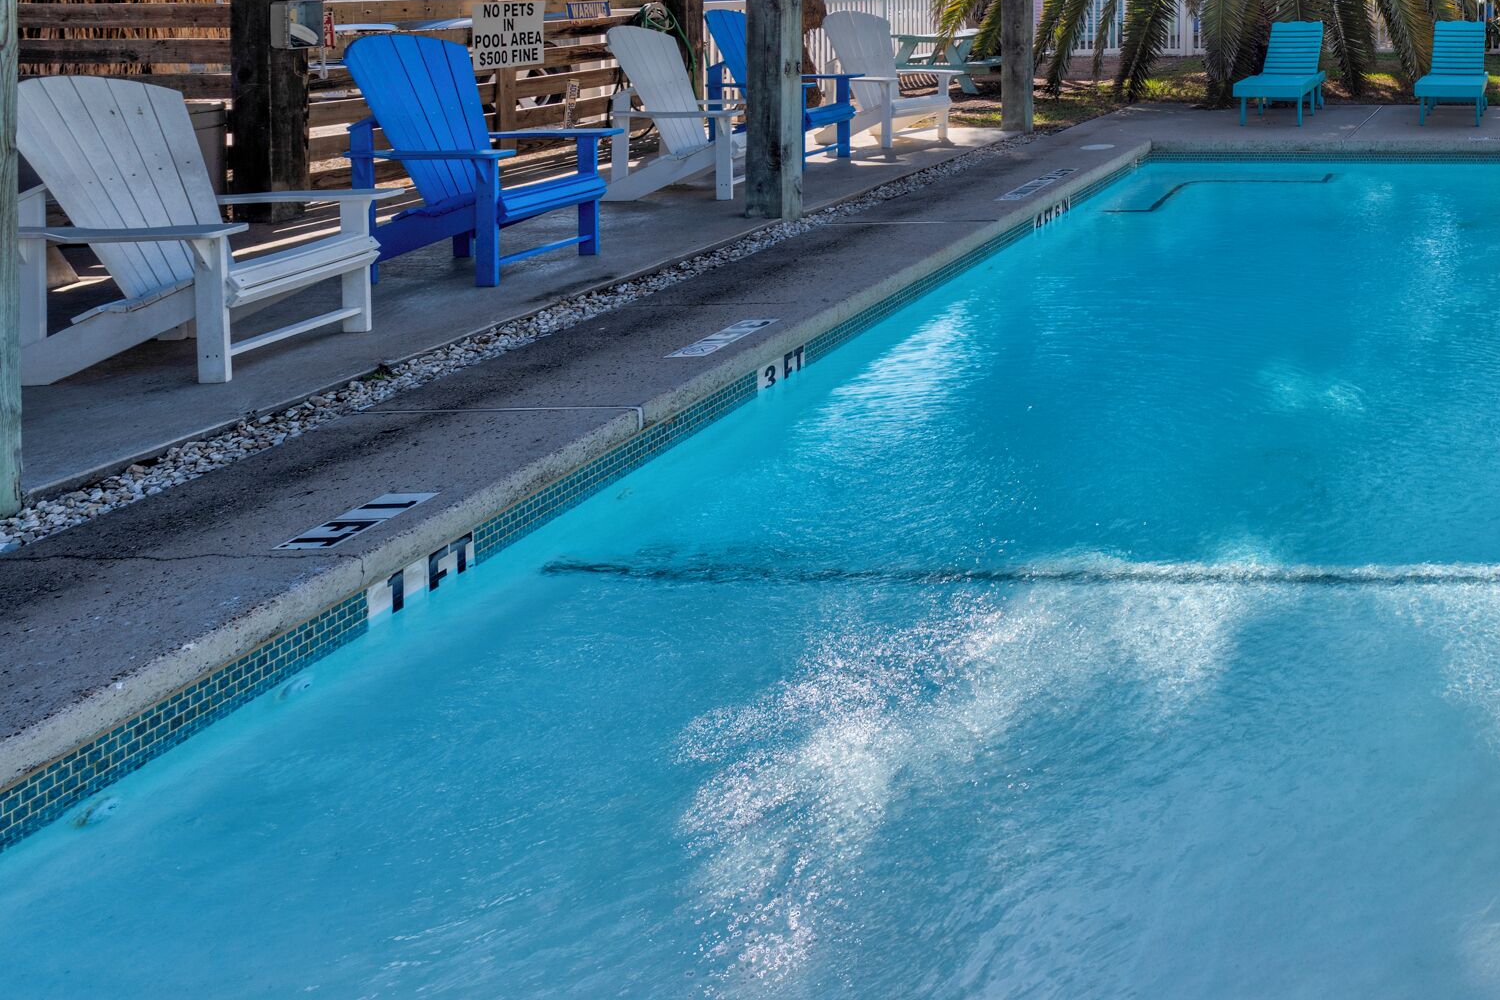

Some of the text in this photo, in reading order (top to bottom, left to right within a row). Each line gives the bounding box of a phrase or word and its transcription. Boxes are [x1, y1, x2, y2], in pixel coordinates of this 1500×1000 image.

[483, 3, 534, 18] NO PETS
[503, 19, 514, 31] IN
[475, 31, 542, 49] POOL AREA
[479, 48, 538, 66] $500 FINE
[764, 365, 776, 389] 3
[387, 568, 404, 614] 1
